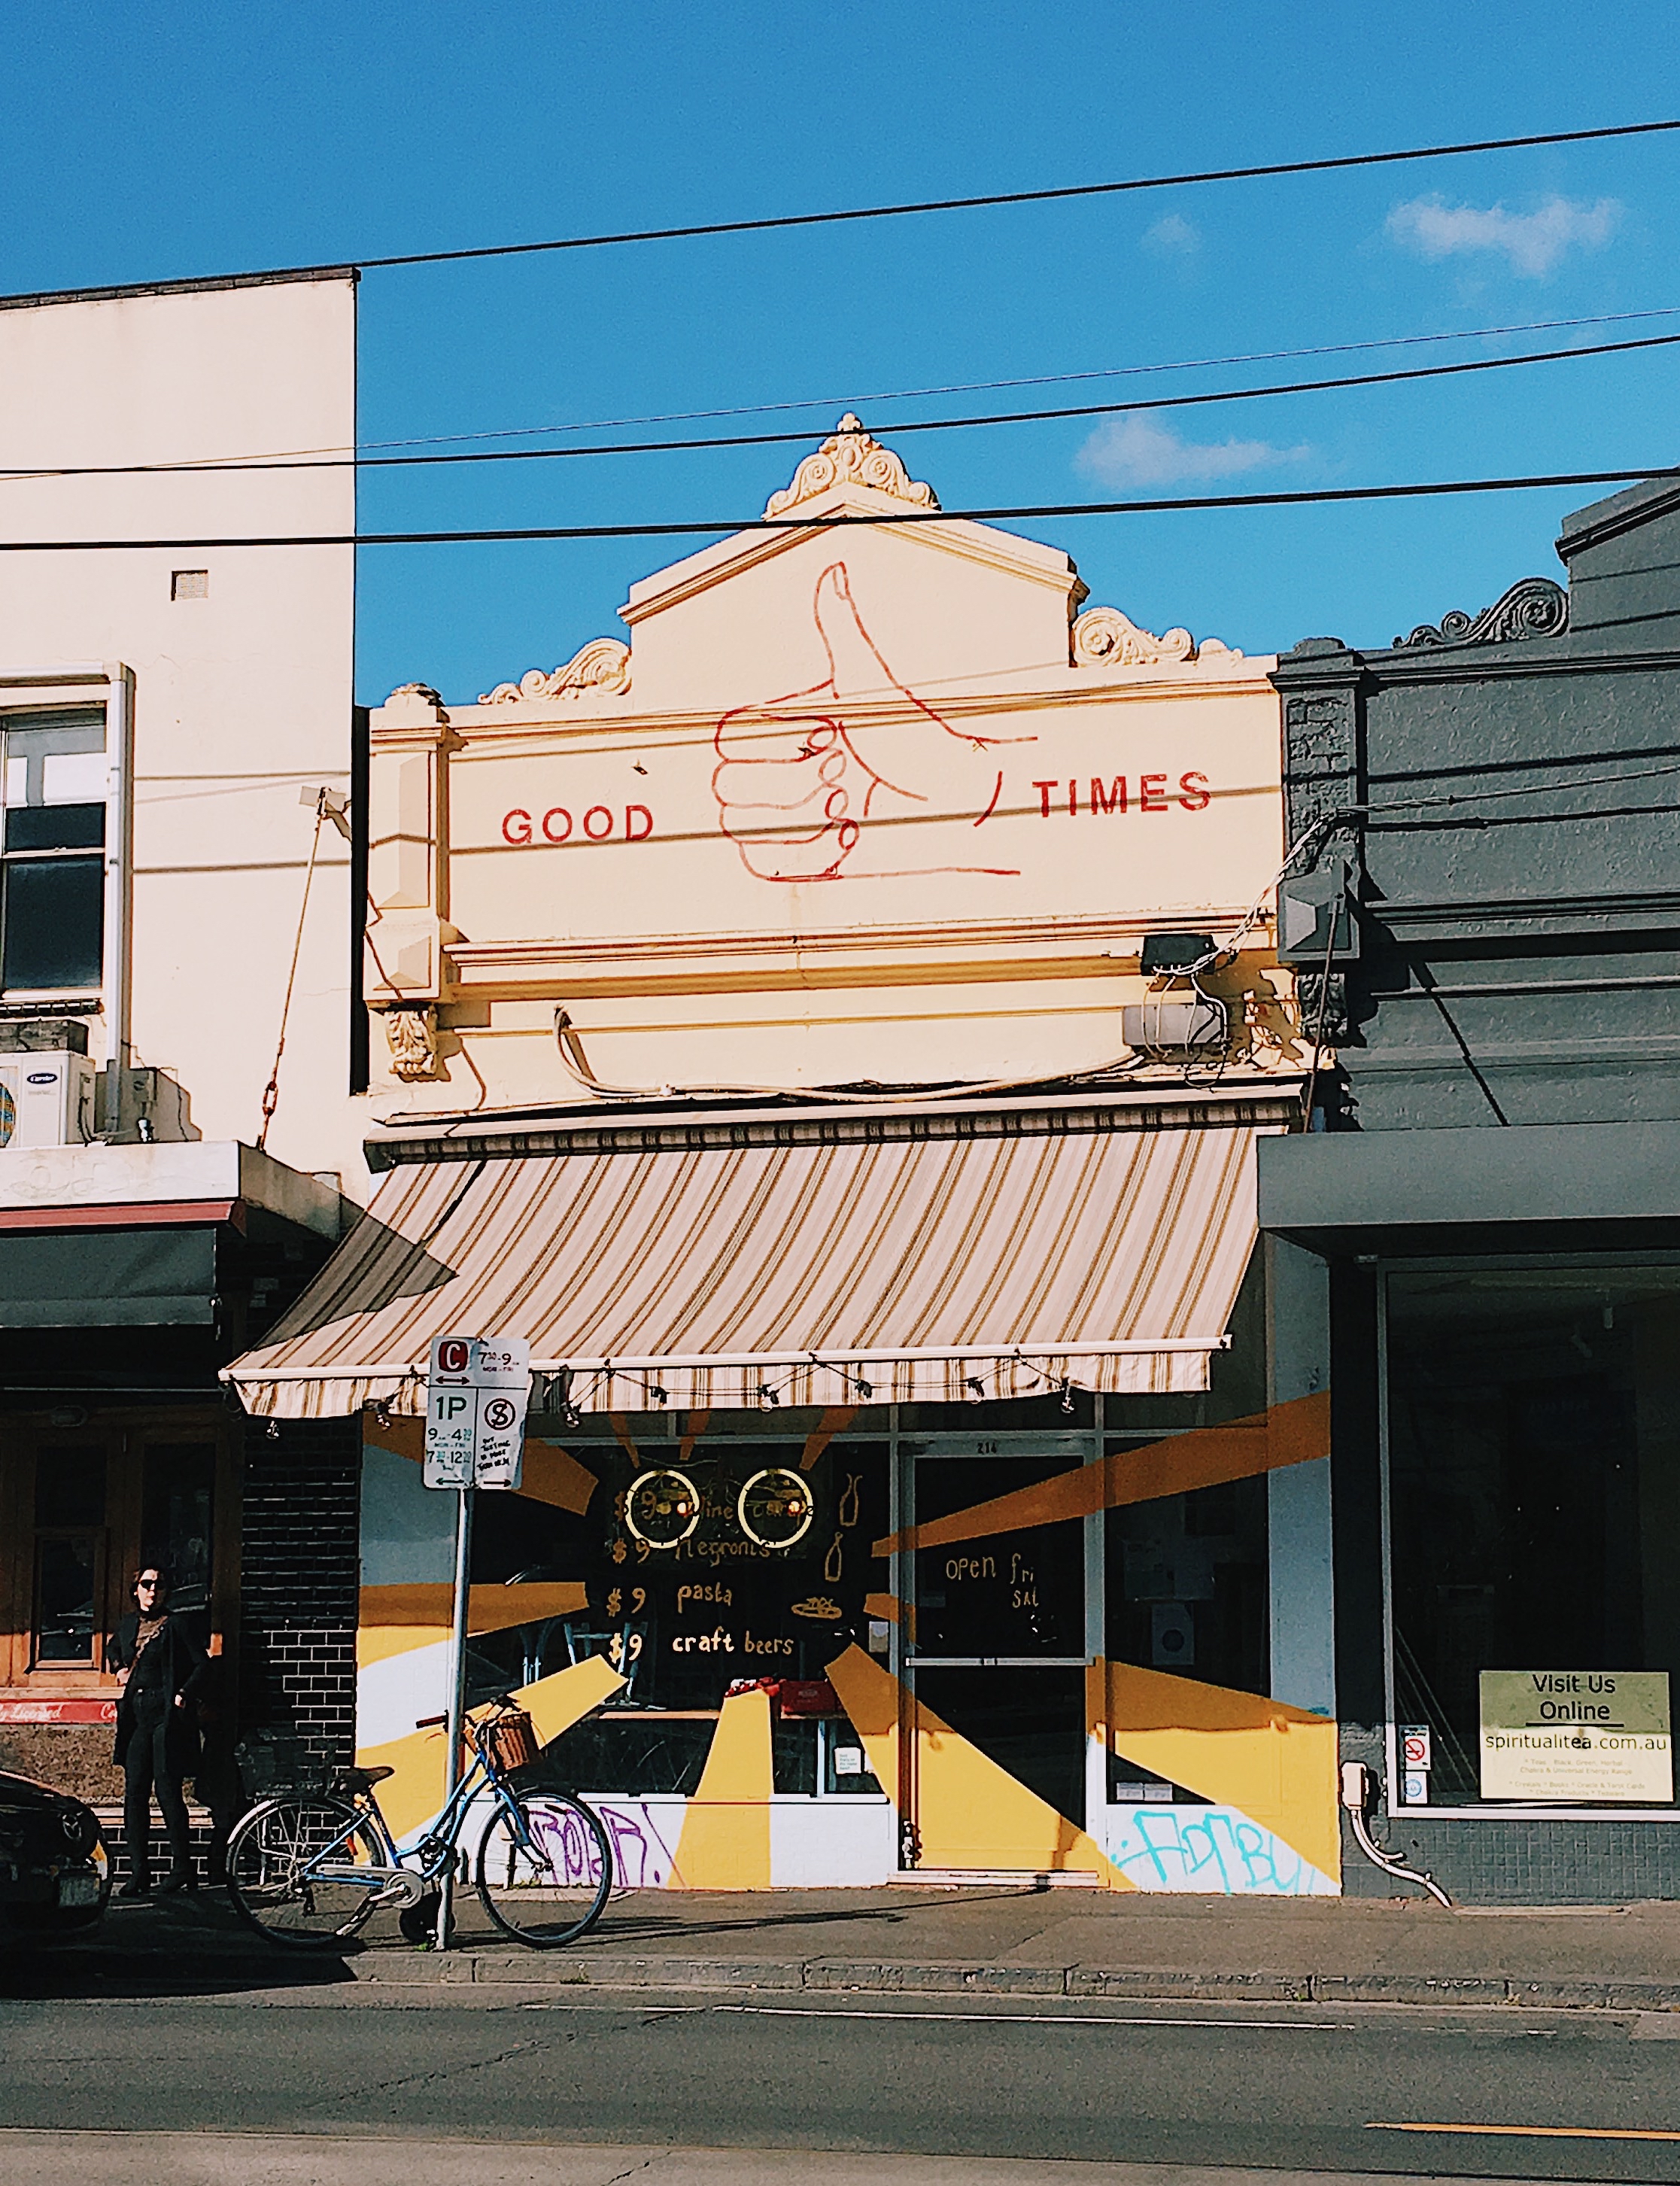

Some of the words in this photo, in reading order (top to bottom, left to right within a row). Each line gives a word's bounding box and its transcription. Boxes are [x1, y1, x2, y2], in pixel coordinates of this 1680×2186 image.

[502, 804, 654, 845] GOOD
[1031, 771, 1211, 818] TIMES
[436, 1396, 467, 1420] 1P
[677, 1582, 732, 1614] pasta
[672, 1625, 735, 1653] craft
[744, 1630, 794, 1655] beers
[1532, 1674, 1581, 1693] Visit
[1588, 1675, 1616, 1694] Us
[1539, 1701, 1611, 1720] Online
[1485, 1734, 1667, 1751] spiritualitea.com.au
